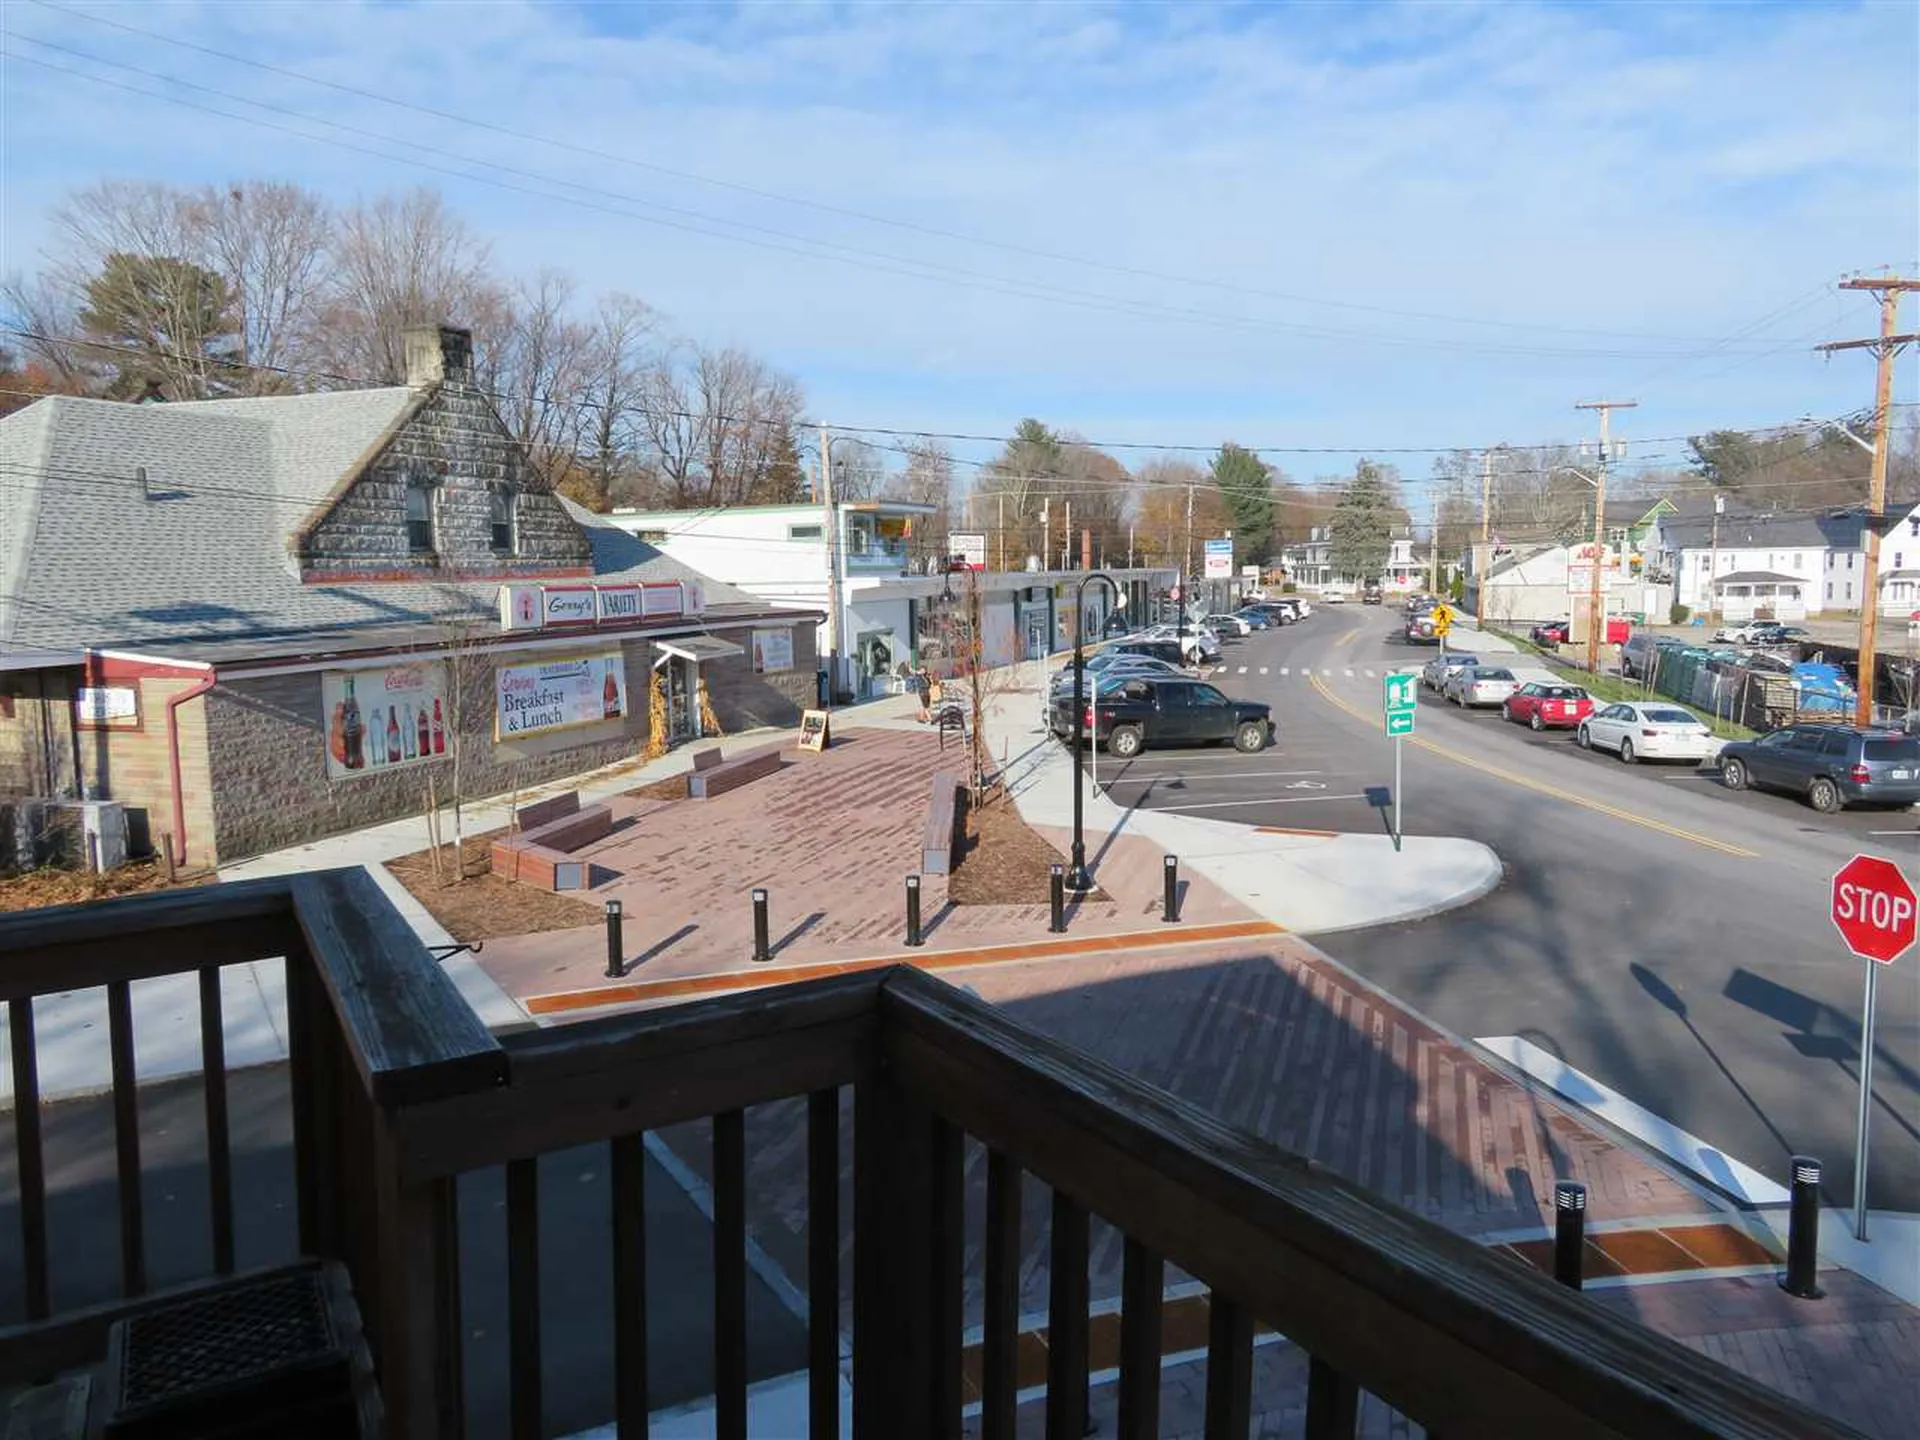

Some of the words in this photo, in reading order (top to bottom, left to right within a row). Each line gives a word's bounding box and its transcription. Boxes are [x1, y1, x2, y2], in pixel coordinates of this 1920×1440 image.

[601, 591, 637, 616] VARIETY
[503, 688, 564, 713] Breakfast
[508, 715, 519, 731] &
[521, 706, 563, 729] Lunch
[1837, 882, 1912, 933] STOP
